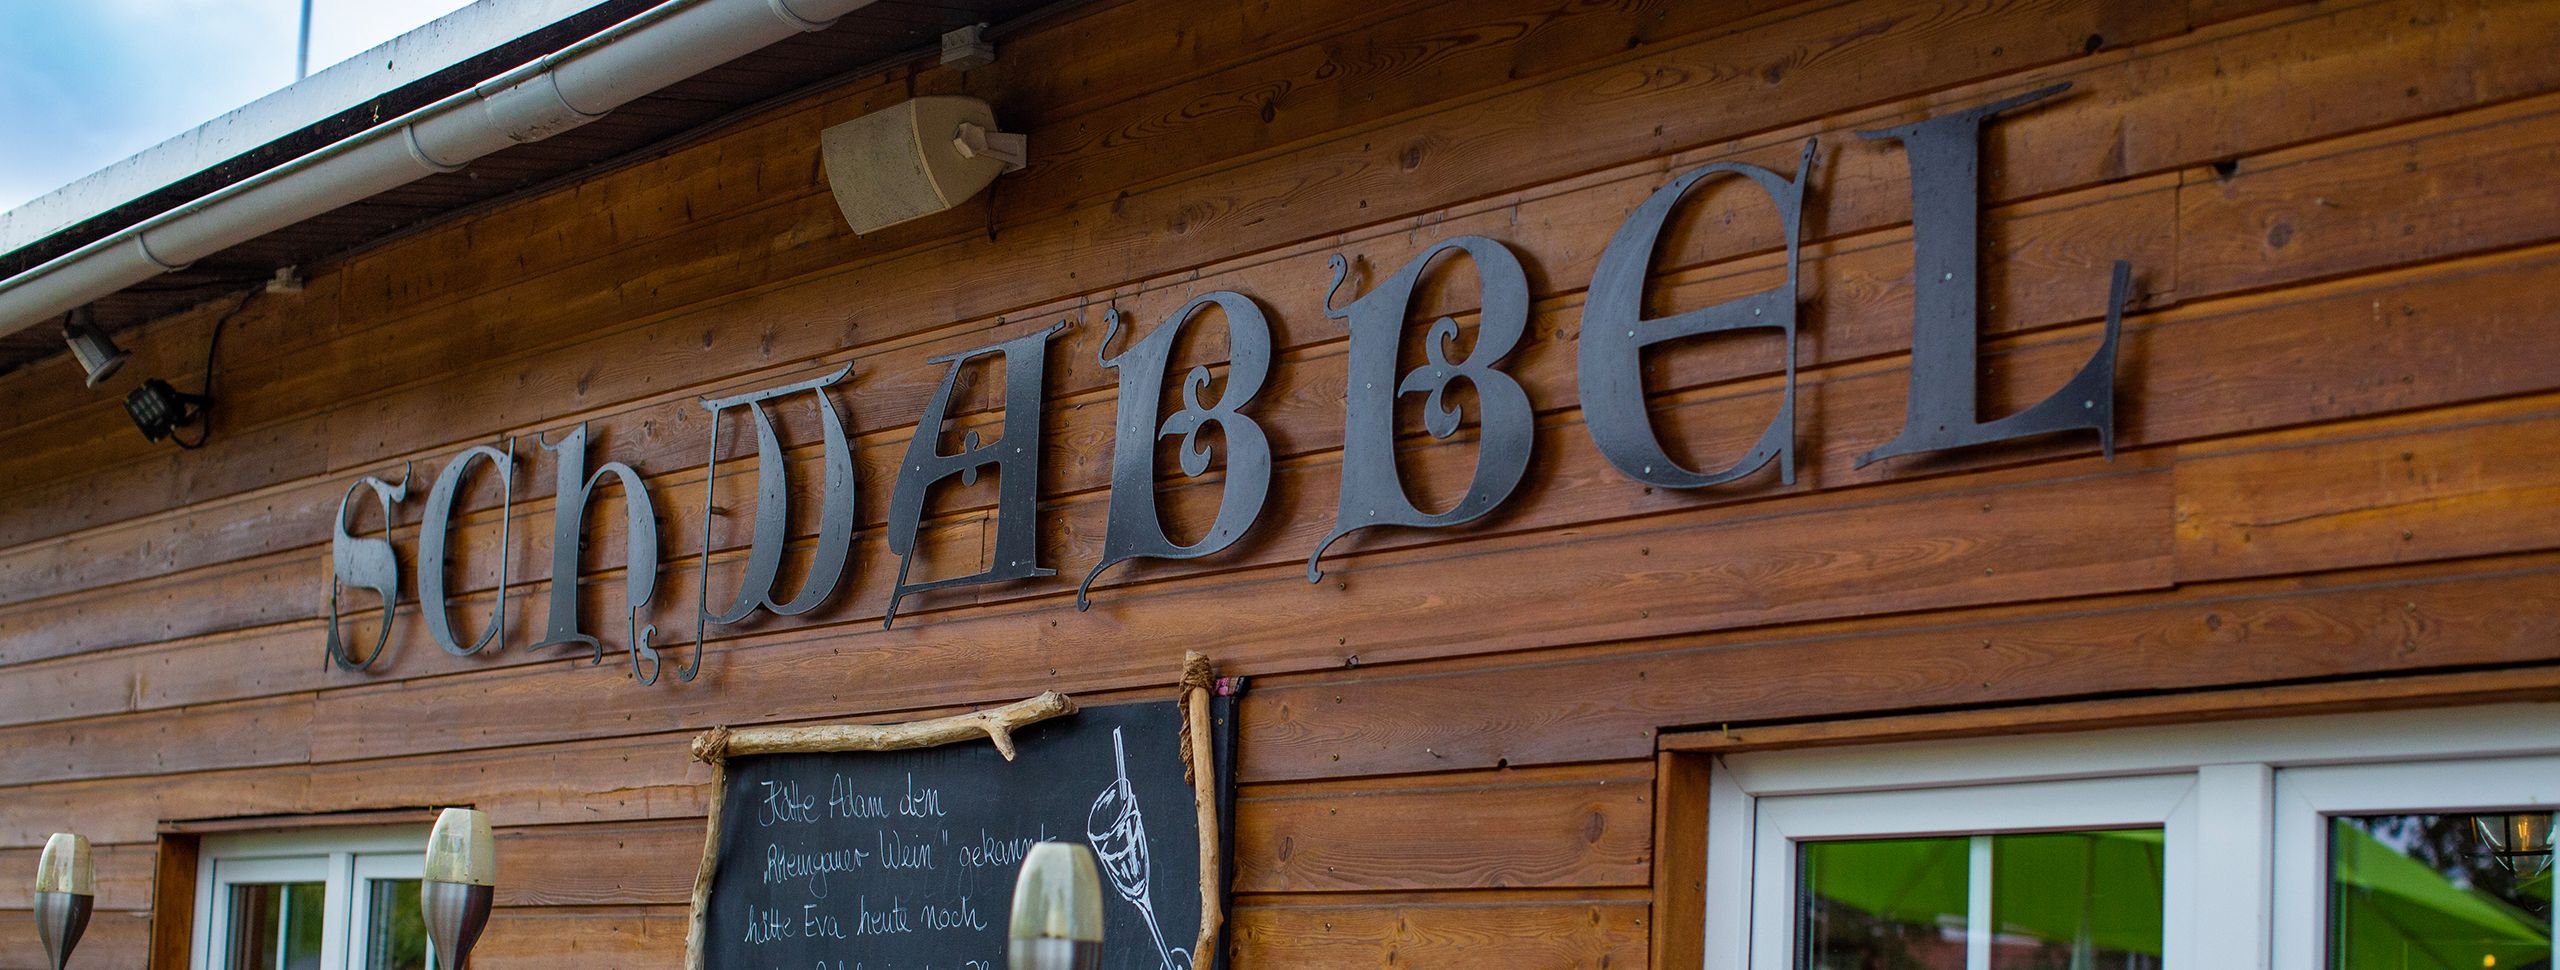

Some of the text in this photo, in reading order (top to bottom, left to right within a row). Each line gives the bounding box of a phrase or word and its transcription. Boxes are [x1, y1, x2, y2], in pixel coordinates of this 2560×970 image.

[828, 772, 891, 819] Adam
[899, 771, 948, 818] den
[744, 894, 988, 945] hätte Eva heute noch
